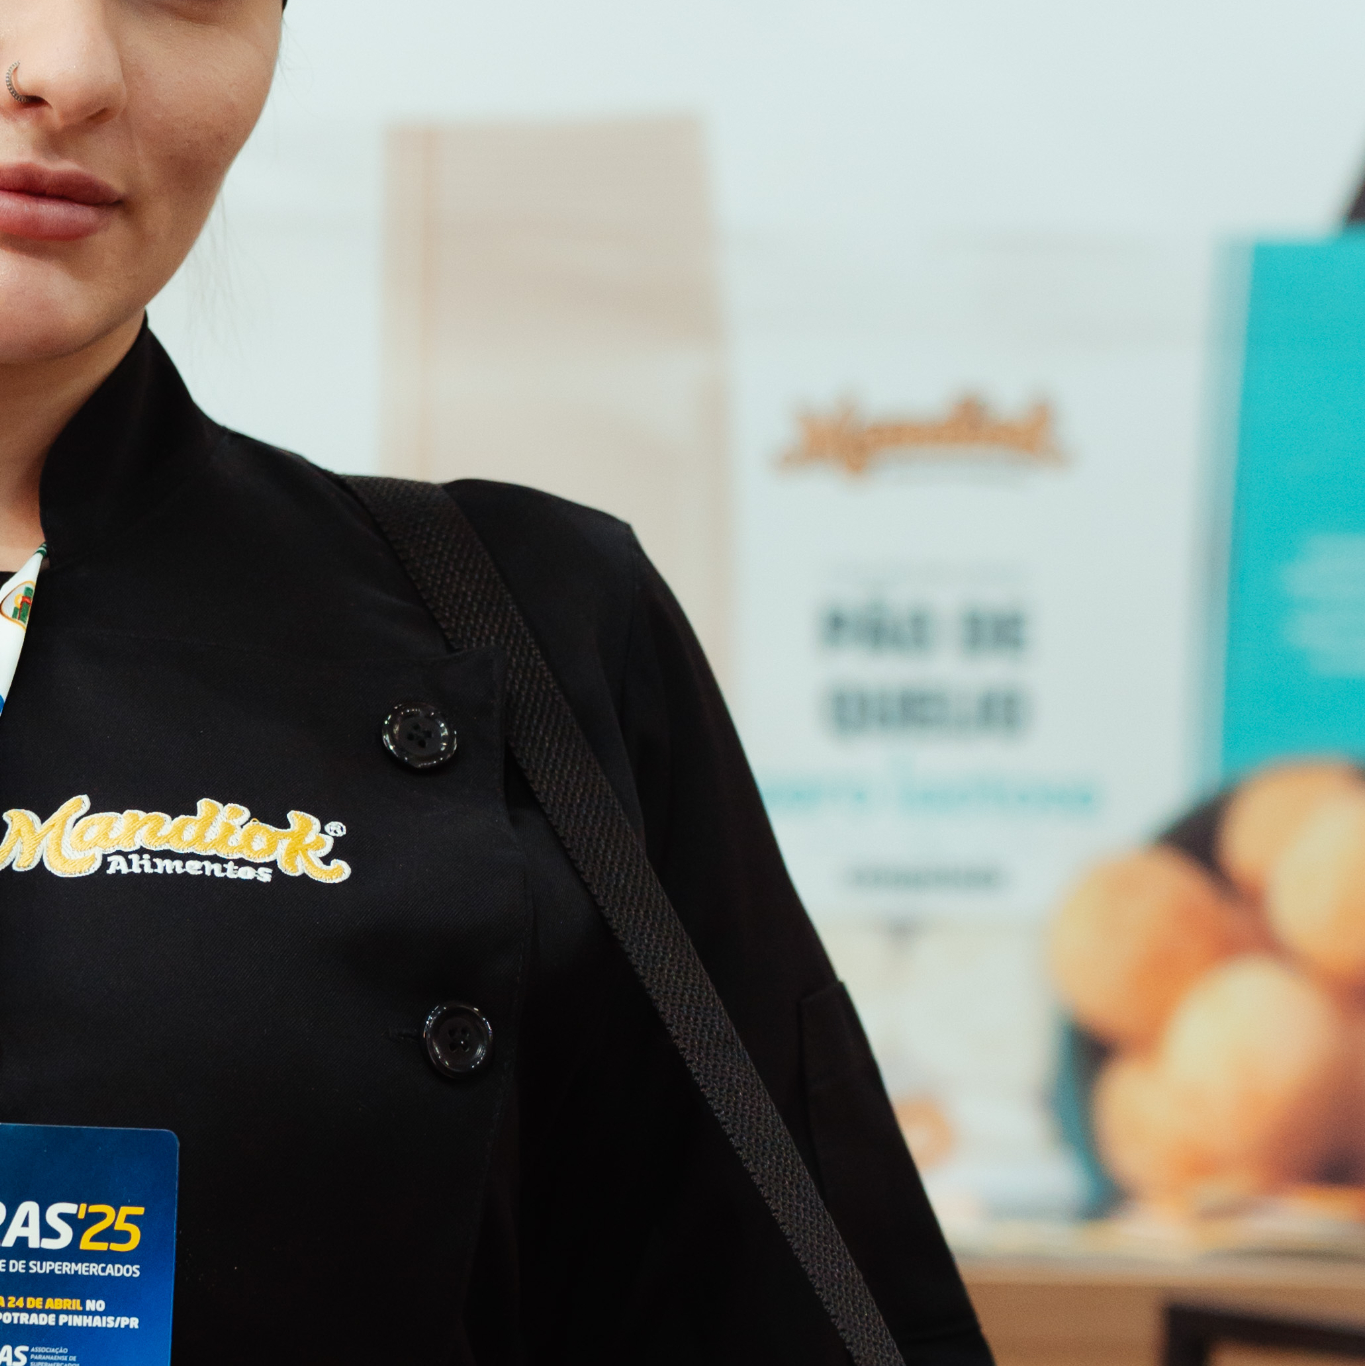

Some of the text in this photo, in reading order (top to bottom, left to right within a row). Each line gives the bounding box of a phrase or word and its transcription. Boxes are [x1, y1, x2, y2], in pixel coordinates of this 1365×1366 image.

[106, 853, 273, 883] Alimentos
[9, 1259, 27, 1274] DE
[28, 1260, 141, 1278] SUPERMERCADOS
[7, 1296, 25, 1309] 24
[26, 1297, 43, 1310] DE
[44, 1297, 83, 1311] ABRIL
[85, 1299, 106, 1312] NO
[58, 1313, 140, 1329] PINHAIS/PR
[30, 1346, 69, 1355] ASSOCIAÇÃO
